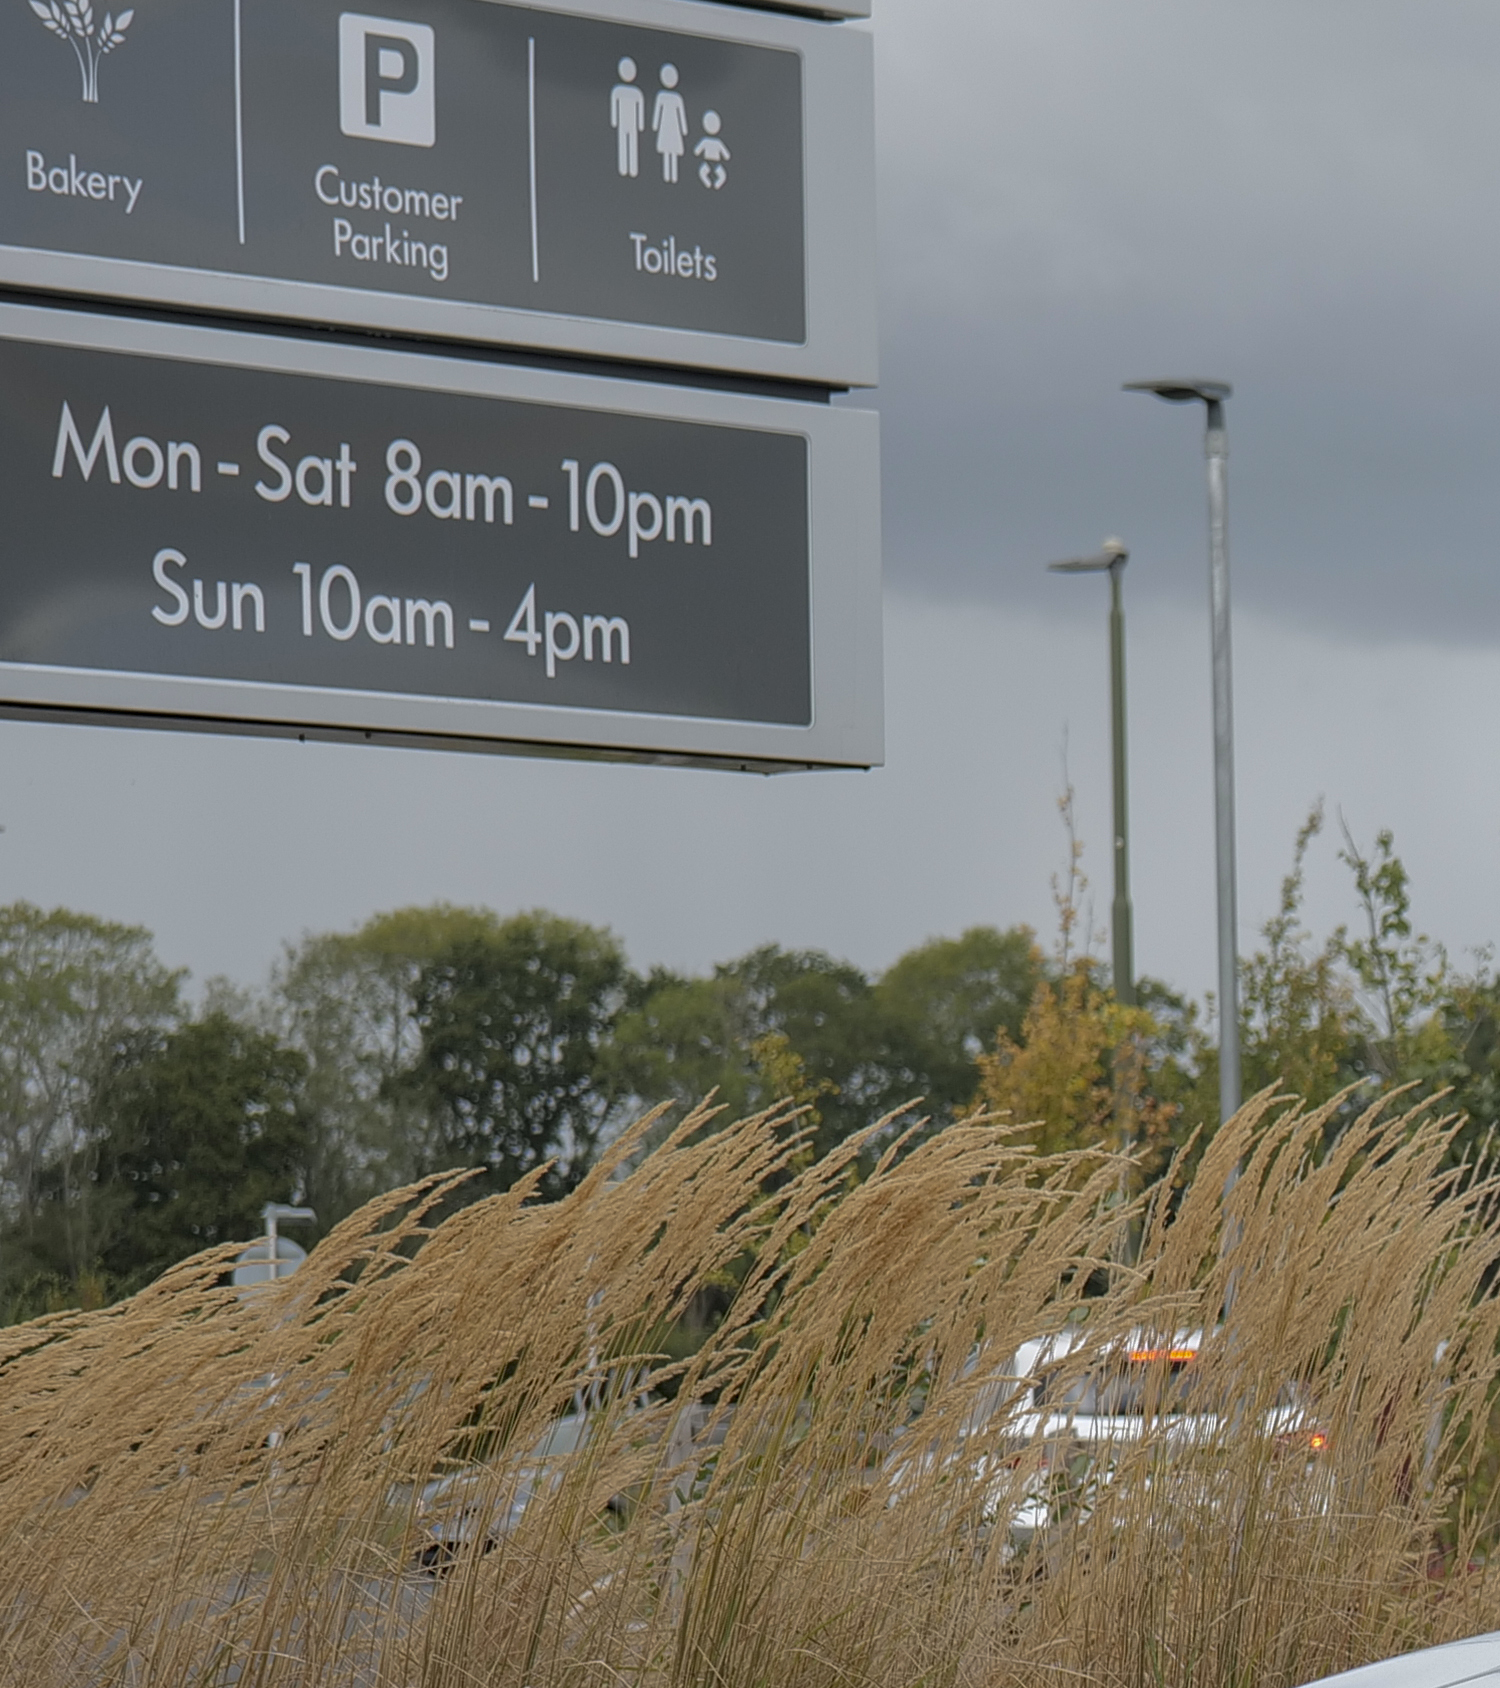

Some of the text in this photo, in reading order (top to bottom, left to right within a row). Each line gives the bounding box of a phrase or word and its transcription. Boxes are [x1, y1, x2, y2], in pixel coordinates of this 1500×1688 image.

[26, 151, 143, 213] Bakery
[315, 165, 462, 222] Customer
[333, 219, 449, 280] Parking
[630, 233, 718, 281] Toilets
[152, 549, 266, 632] Sun
